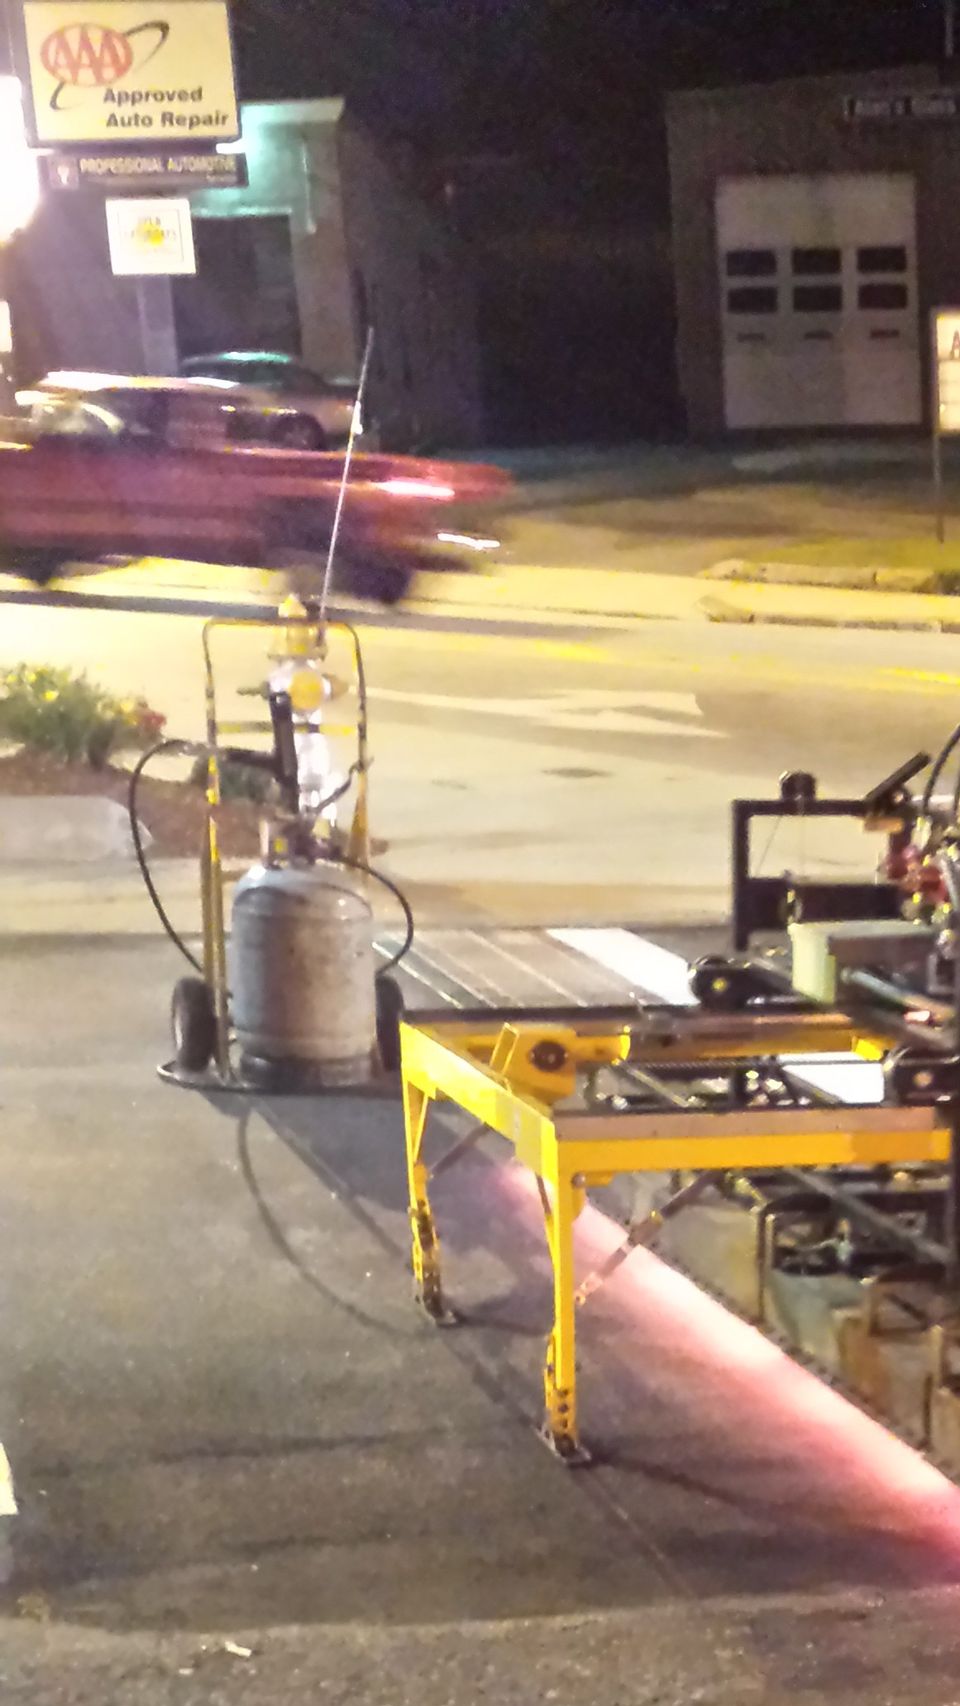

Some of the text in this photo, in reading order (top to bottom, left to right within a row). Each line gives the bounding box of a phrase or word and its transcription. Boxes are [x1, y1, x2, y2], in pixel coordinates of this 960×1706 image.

[44, 24, 130, 85] AAA
[103, 86, 203, 107] Approved
[106, 110, 229, 130] Auto Repair
[79, 156, 165, 174] PROFESSIONAL
